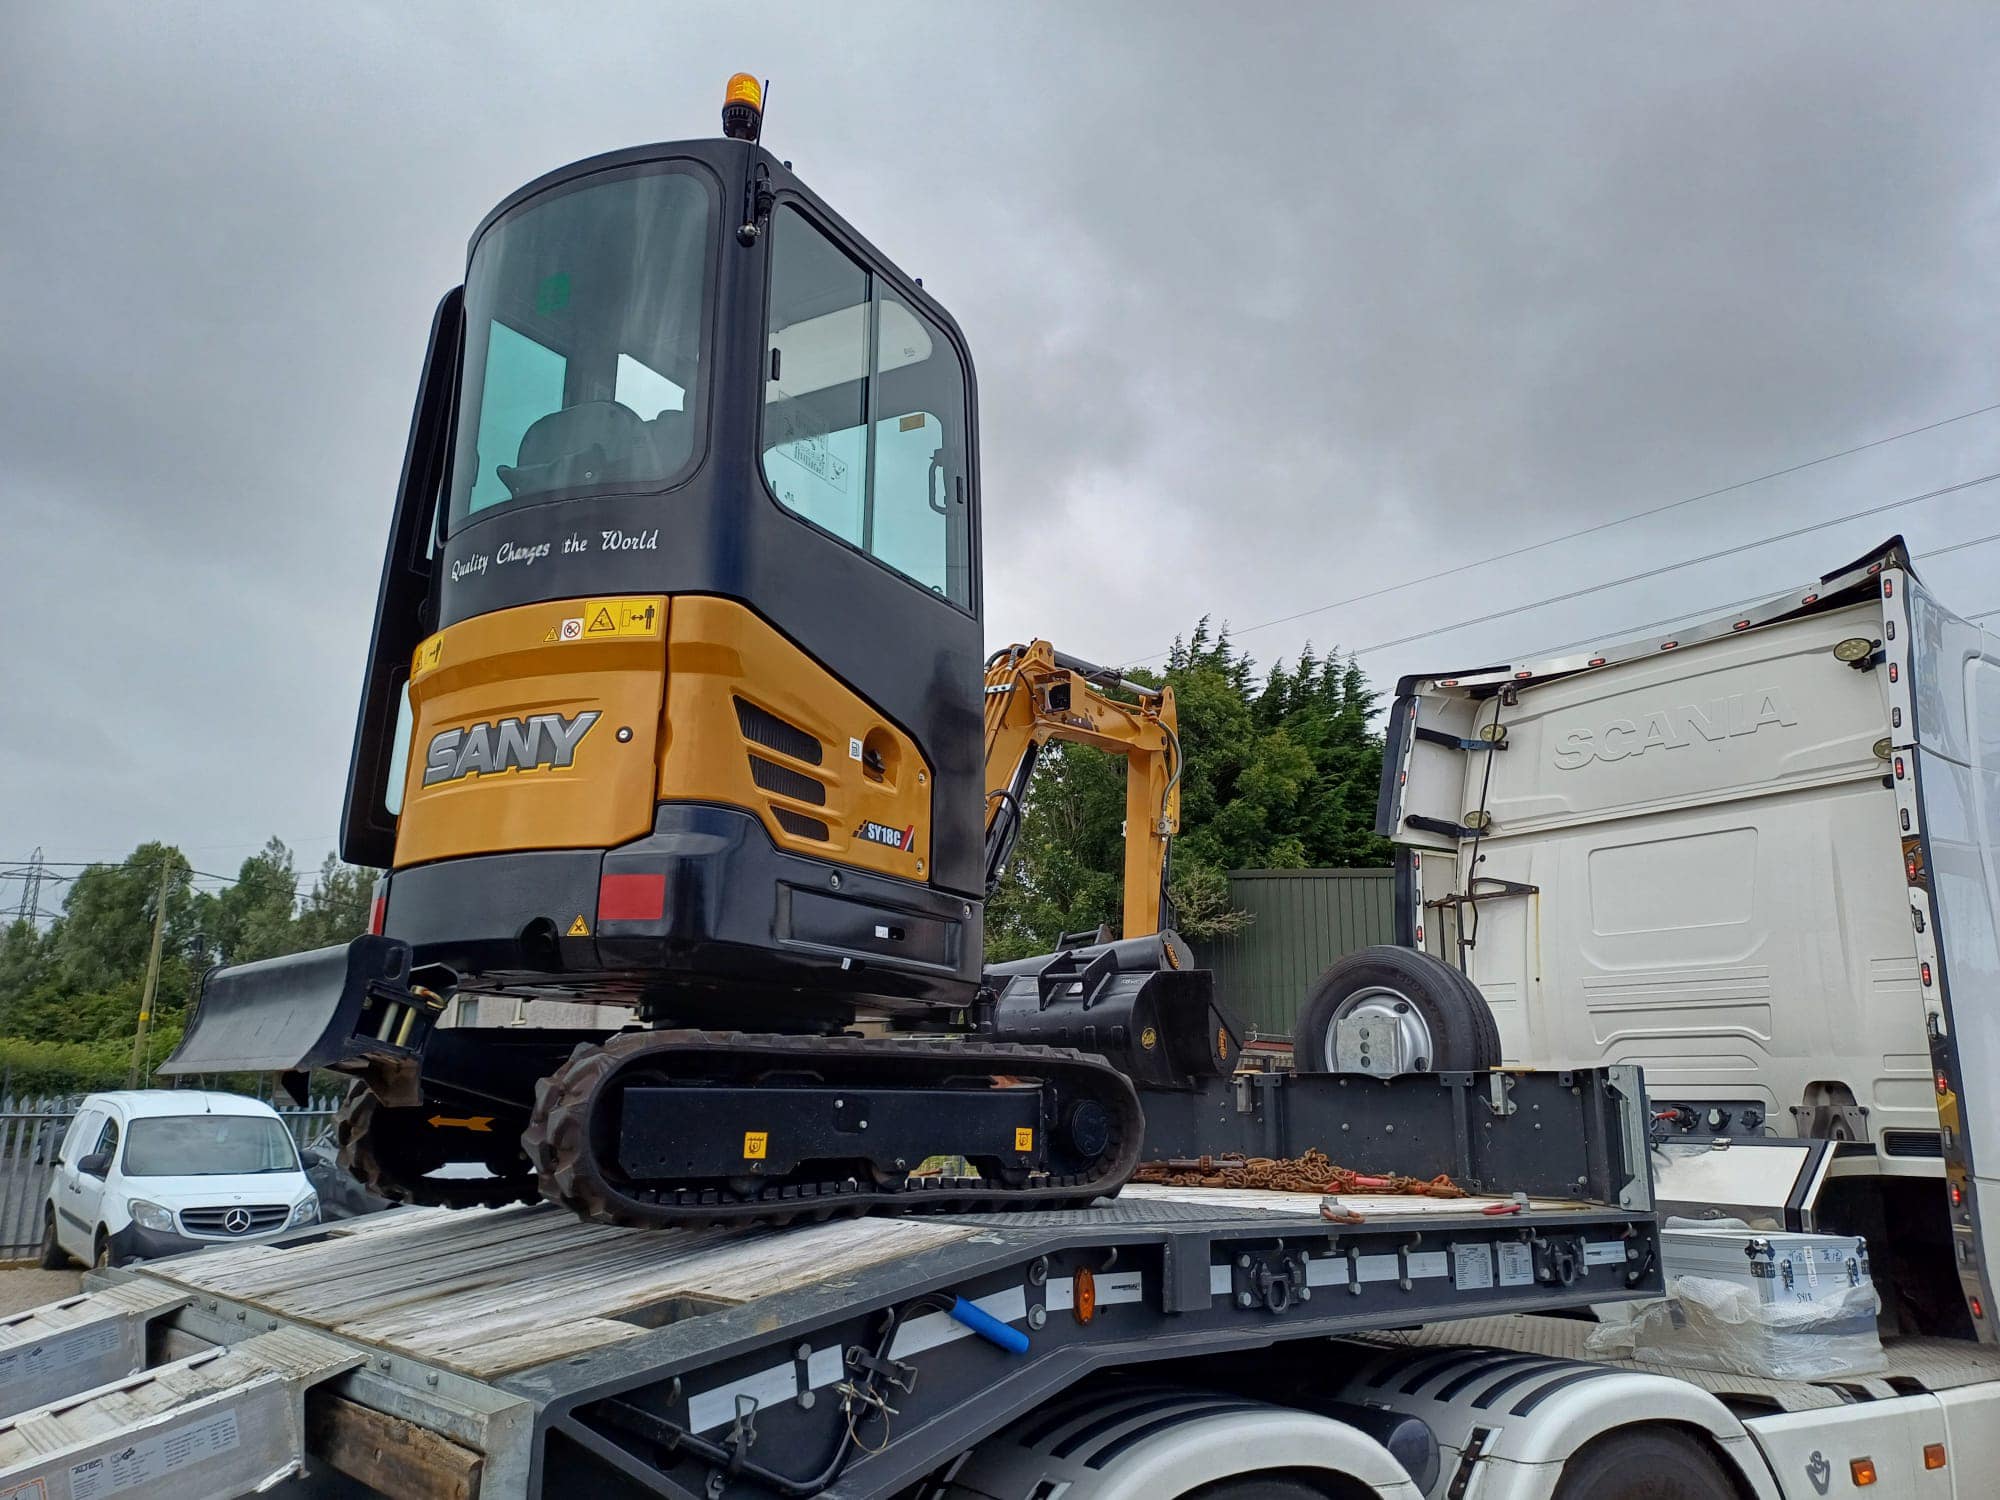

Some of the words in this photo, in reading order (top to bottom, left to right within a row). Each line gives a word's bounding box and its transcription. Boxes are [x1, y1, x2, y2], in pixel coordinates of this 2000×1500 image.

[451, 554, 489, 582] Quality
[496, 542, 550, 565] Changes
[563, 532, 588, 553] the
[601, 529, 659, 550] World
[423, 710, 603, 789] SANY
[1553, 687, 1798, 770] SCANIA
[867, 822, 901, 847] SY18C
